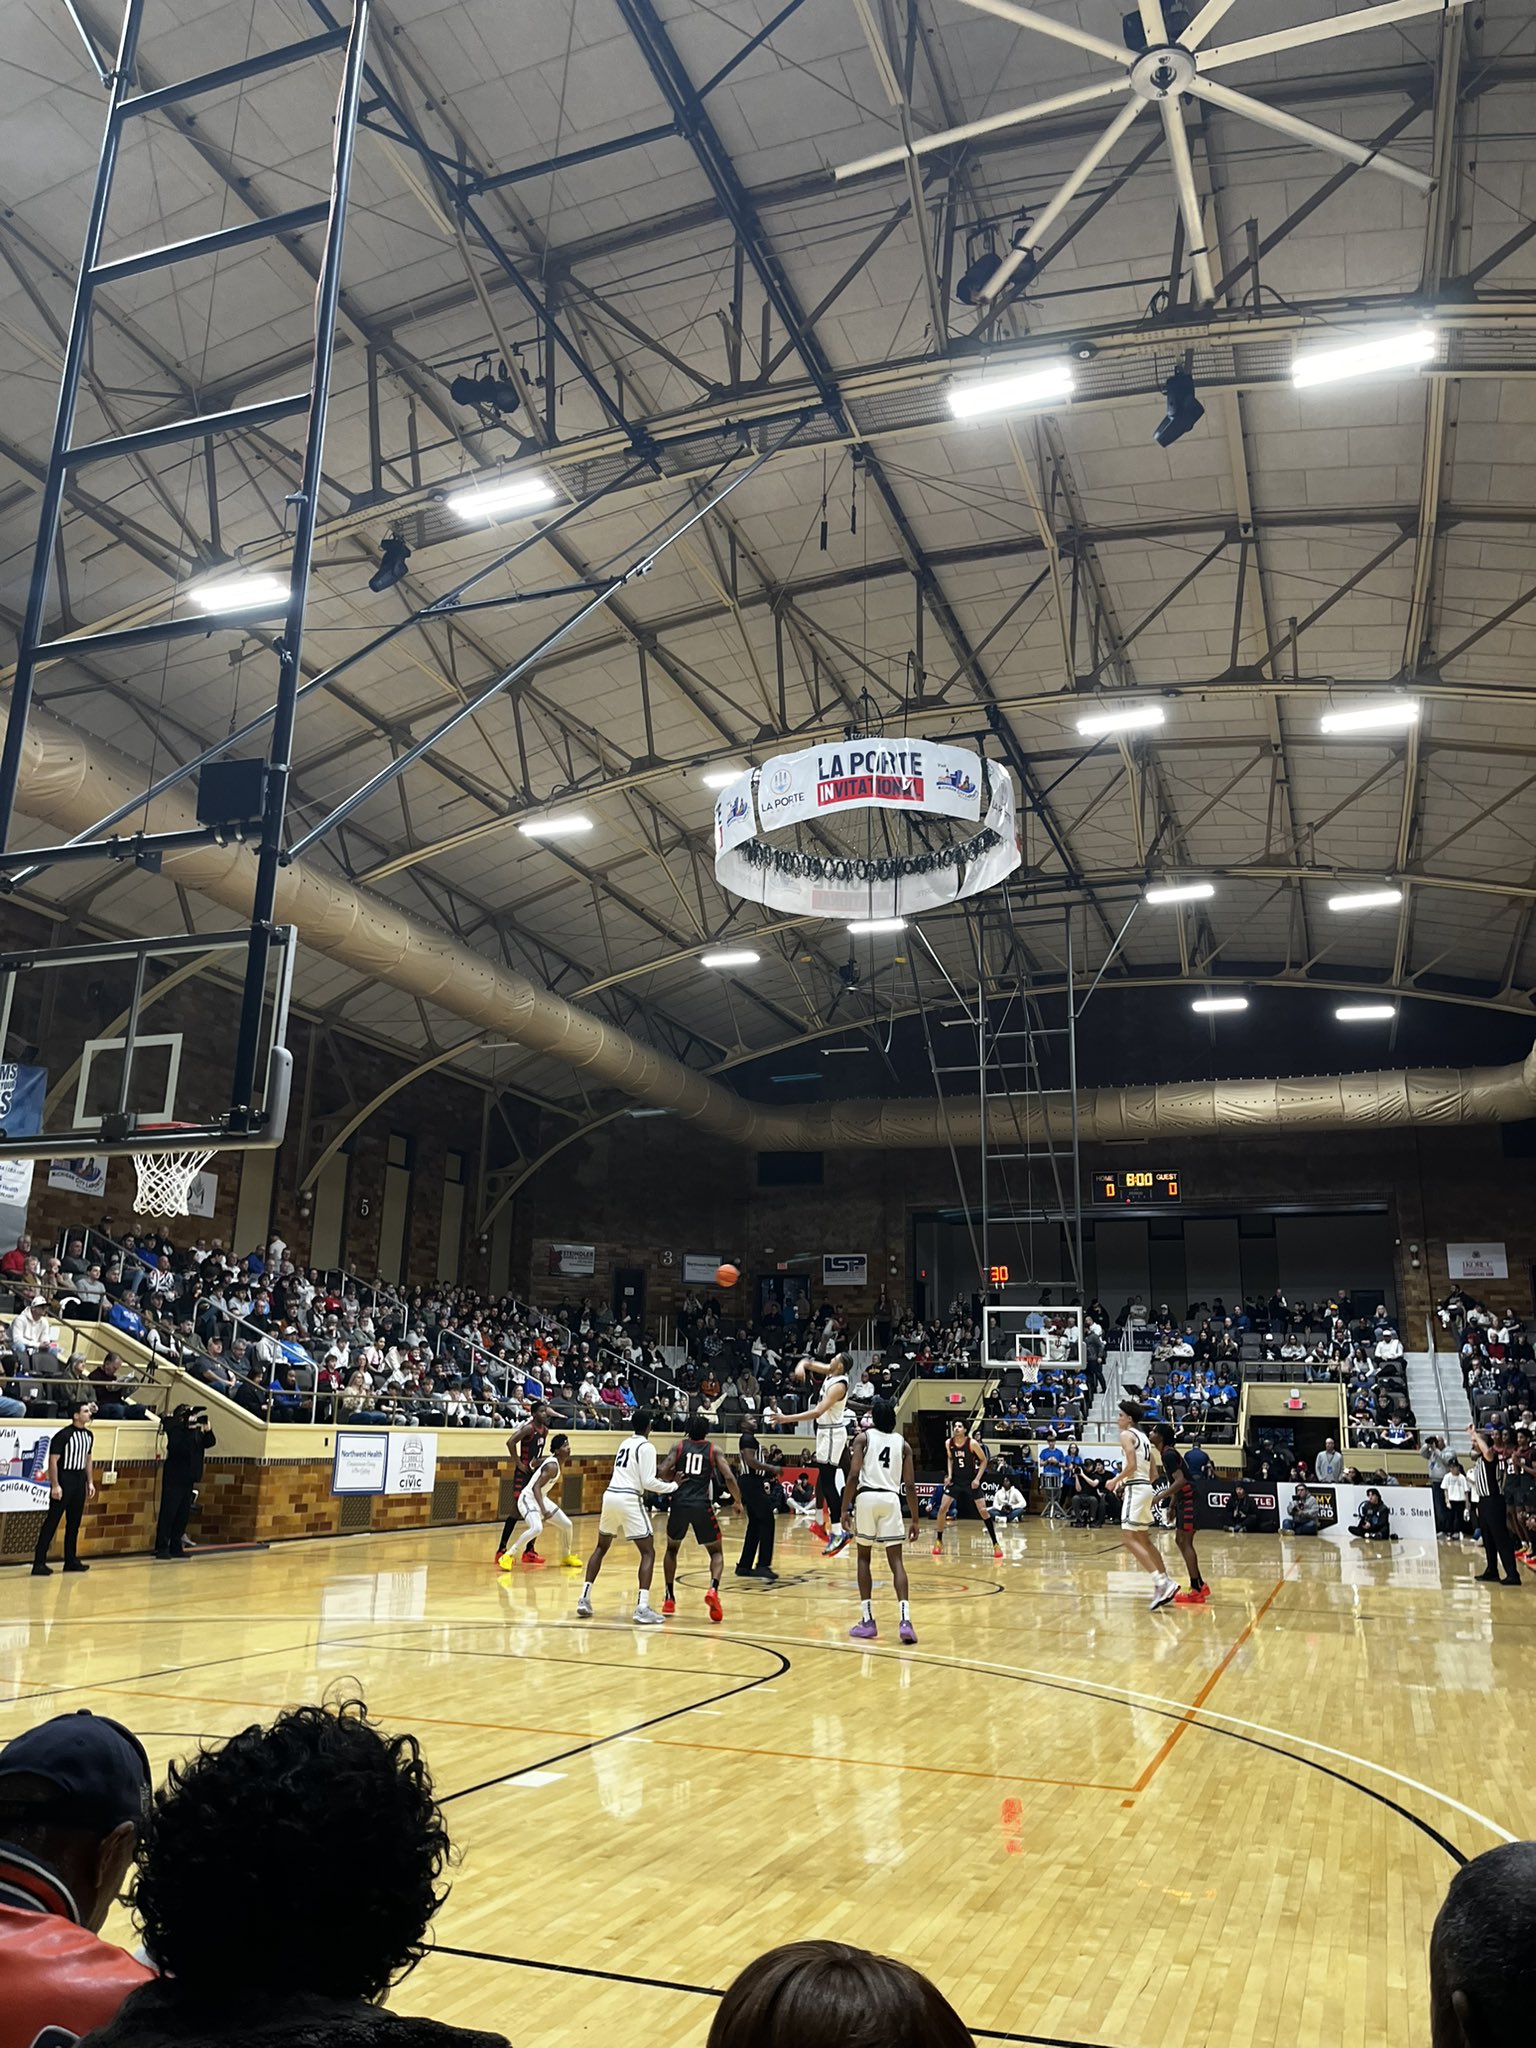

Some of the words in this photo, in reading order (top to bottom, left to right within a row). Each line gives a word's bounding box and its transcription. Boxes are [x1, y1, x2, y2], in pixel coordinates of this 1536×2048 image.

[818, 755, 843, 780] LA
[850, 751, 922, 776] PORTE
[761, 803, 773, 812] LA
[775, 792, 805, 808] PORTE
[1126, 1172, 1153, 1187] 8:00
[1155, 1173, 1177, 1181] GUEST
[1106, 1183, 1115, 1197] 0
[1168, 1182, 1177, 1196] 0
[361, 1199, 369, 1216] 5
[663, 1250, 673, 1265] 3
[991, 1265, 1008, 1281] 30
[0, 1429, 16, 1438] Visit
[341, 1449, 366, 1458] Northwest
[367, 1449, 382, 1457] Health
[615, 1448, 630, 1468] 21
[879, 1446, 891, 1468] 4
[685, 1452, 703, 1475] 10
[958, 1458, 965, 1468] 5
[399, 1478, 422, 1488] CIVIC
[981, 1482, 999, 1492] Only
[1411, 1508, 1432, 1517] Steel
